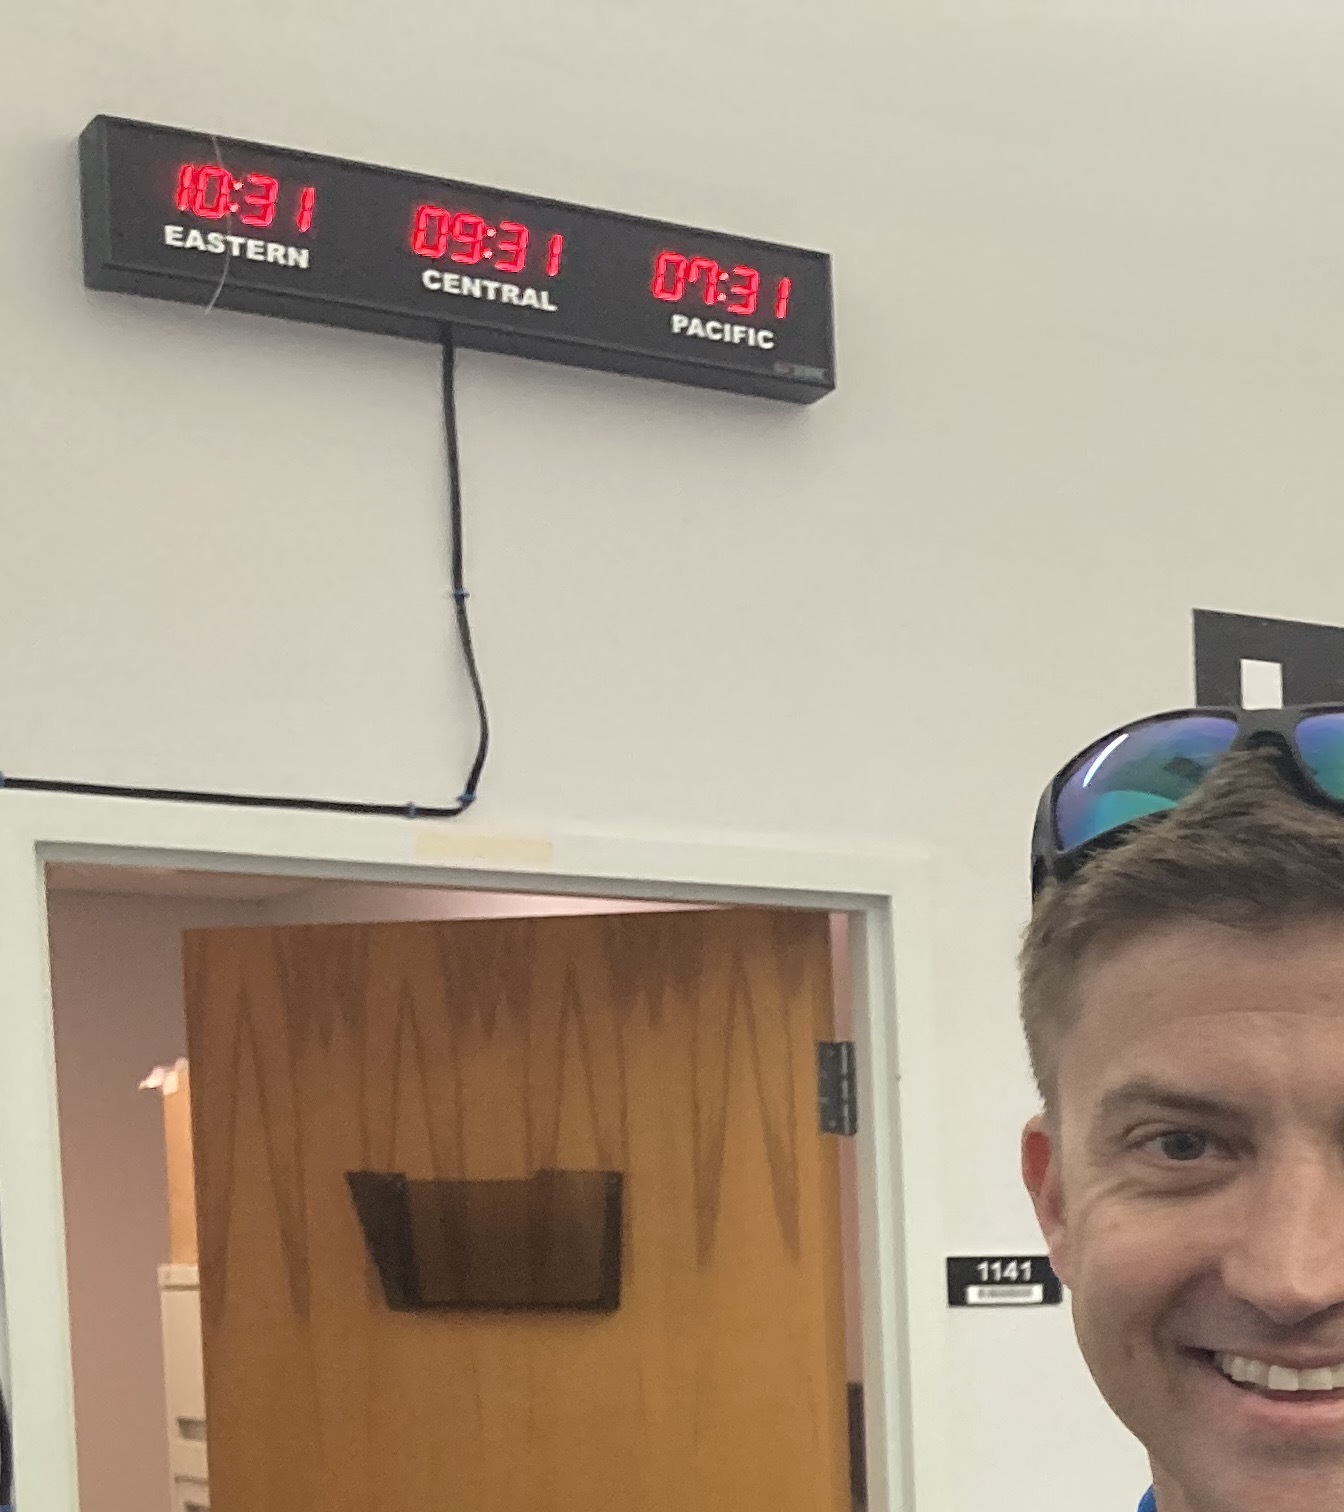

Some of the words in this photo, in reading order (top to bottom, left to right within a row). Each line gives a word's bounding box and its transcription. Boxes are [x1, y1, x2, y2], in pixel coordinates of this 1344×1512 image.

[177, 164, 316, 232] 10:31
[164, 224, 310, 269] EASTERN
[412, 205, 564, 276] 09:31
[421, 269, 559, 312] CENTRAL
[652, 251, 791, 319] 07:31
[671, 313, 775, 350] PACIFIC
[977, 1259, 1032, 1282] 1141
